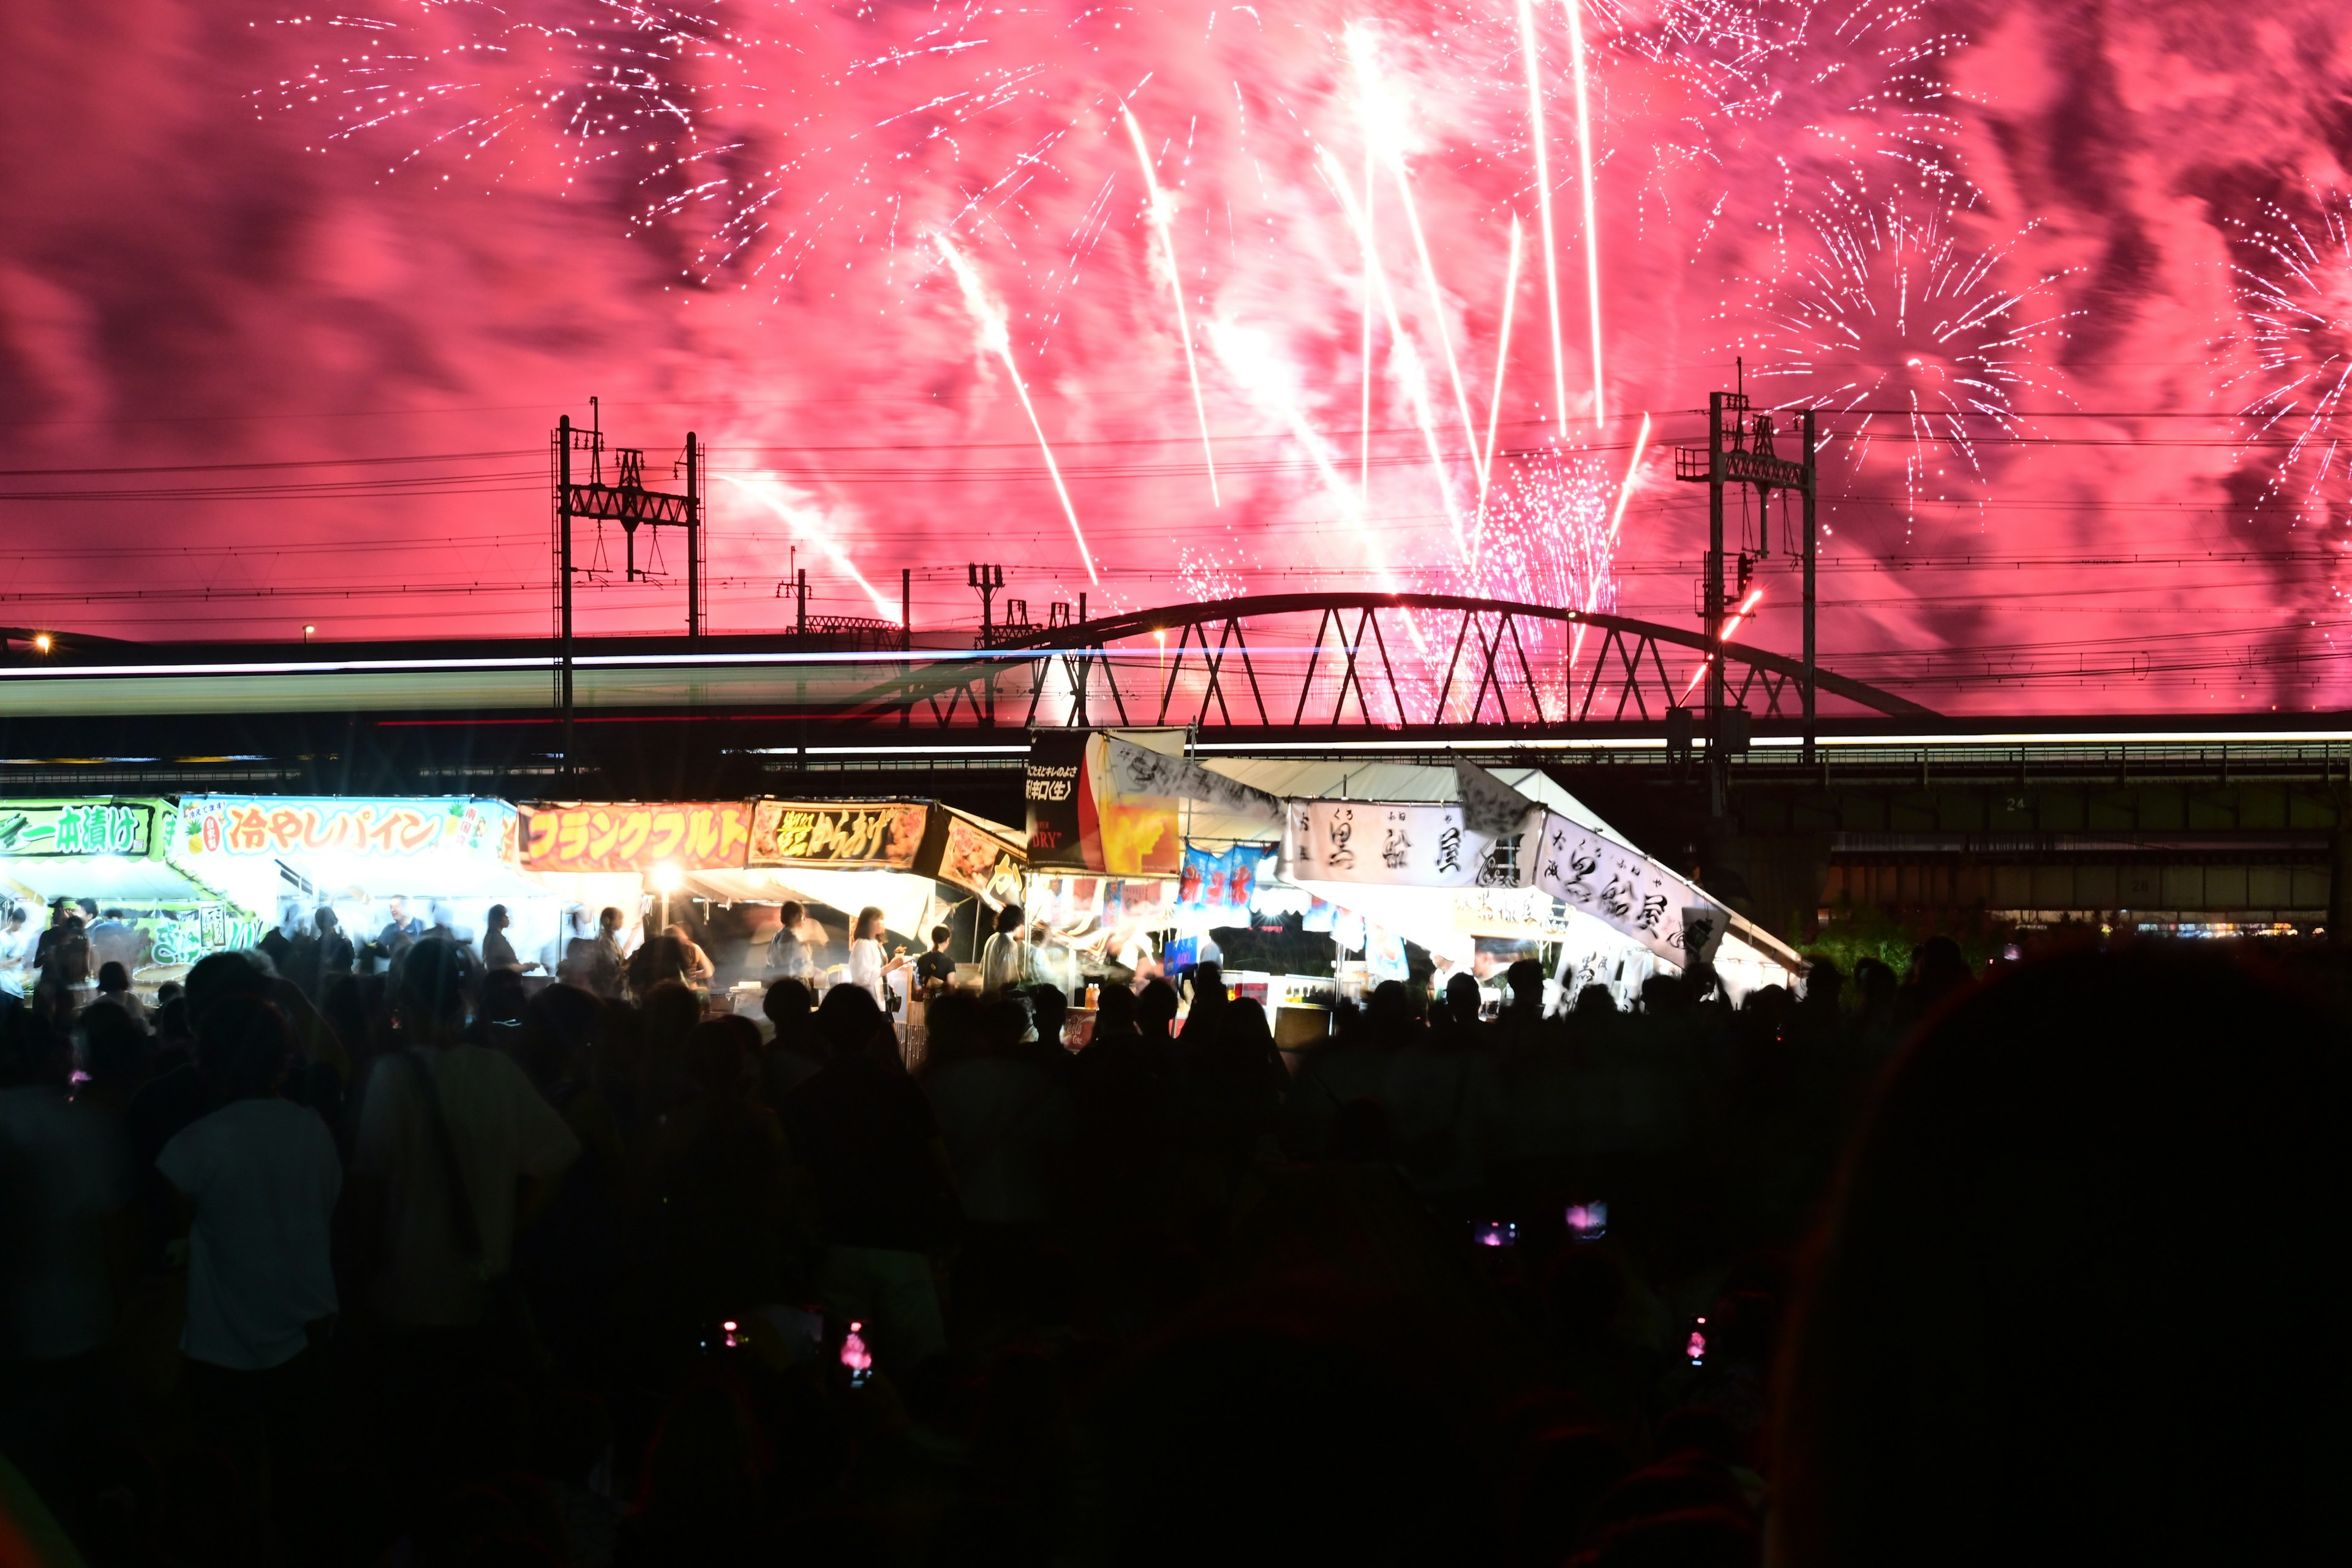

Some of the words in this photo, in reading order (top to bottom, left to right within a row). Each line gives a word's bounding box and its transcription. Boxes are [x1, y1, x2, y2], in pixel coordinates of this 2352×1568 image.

[1027, 765, 1077, 778] ごたえとキレのよさ
[2007, 798, 2025, 811] 24
[18, 805, 138, 853] 一本漬け
[229, 807, 435, 850] 冷やしパイン
[528, 809, 747, 860] フランクフルト
[805, 807, 895, 862] からあげ
